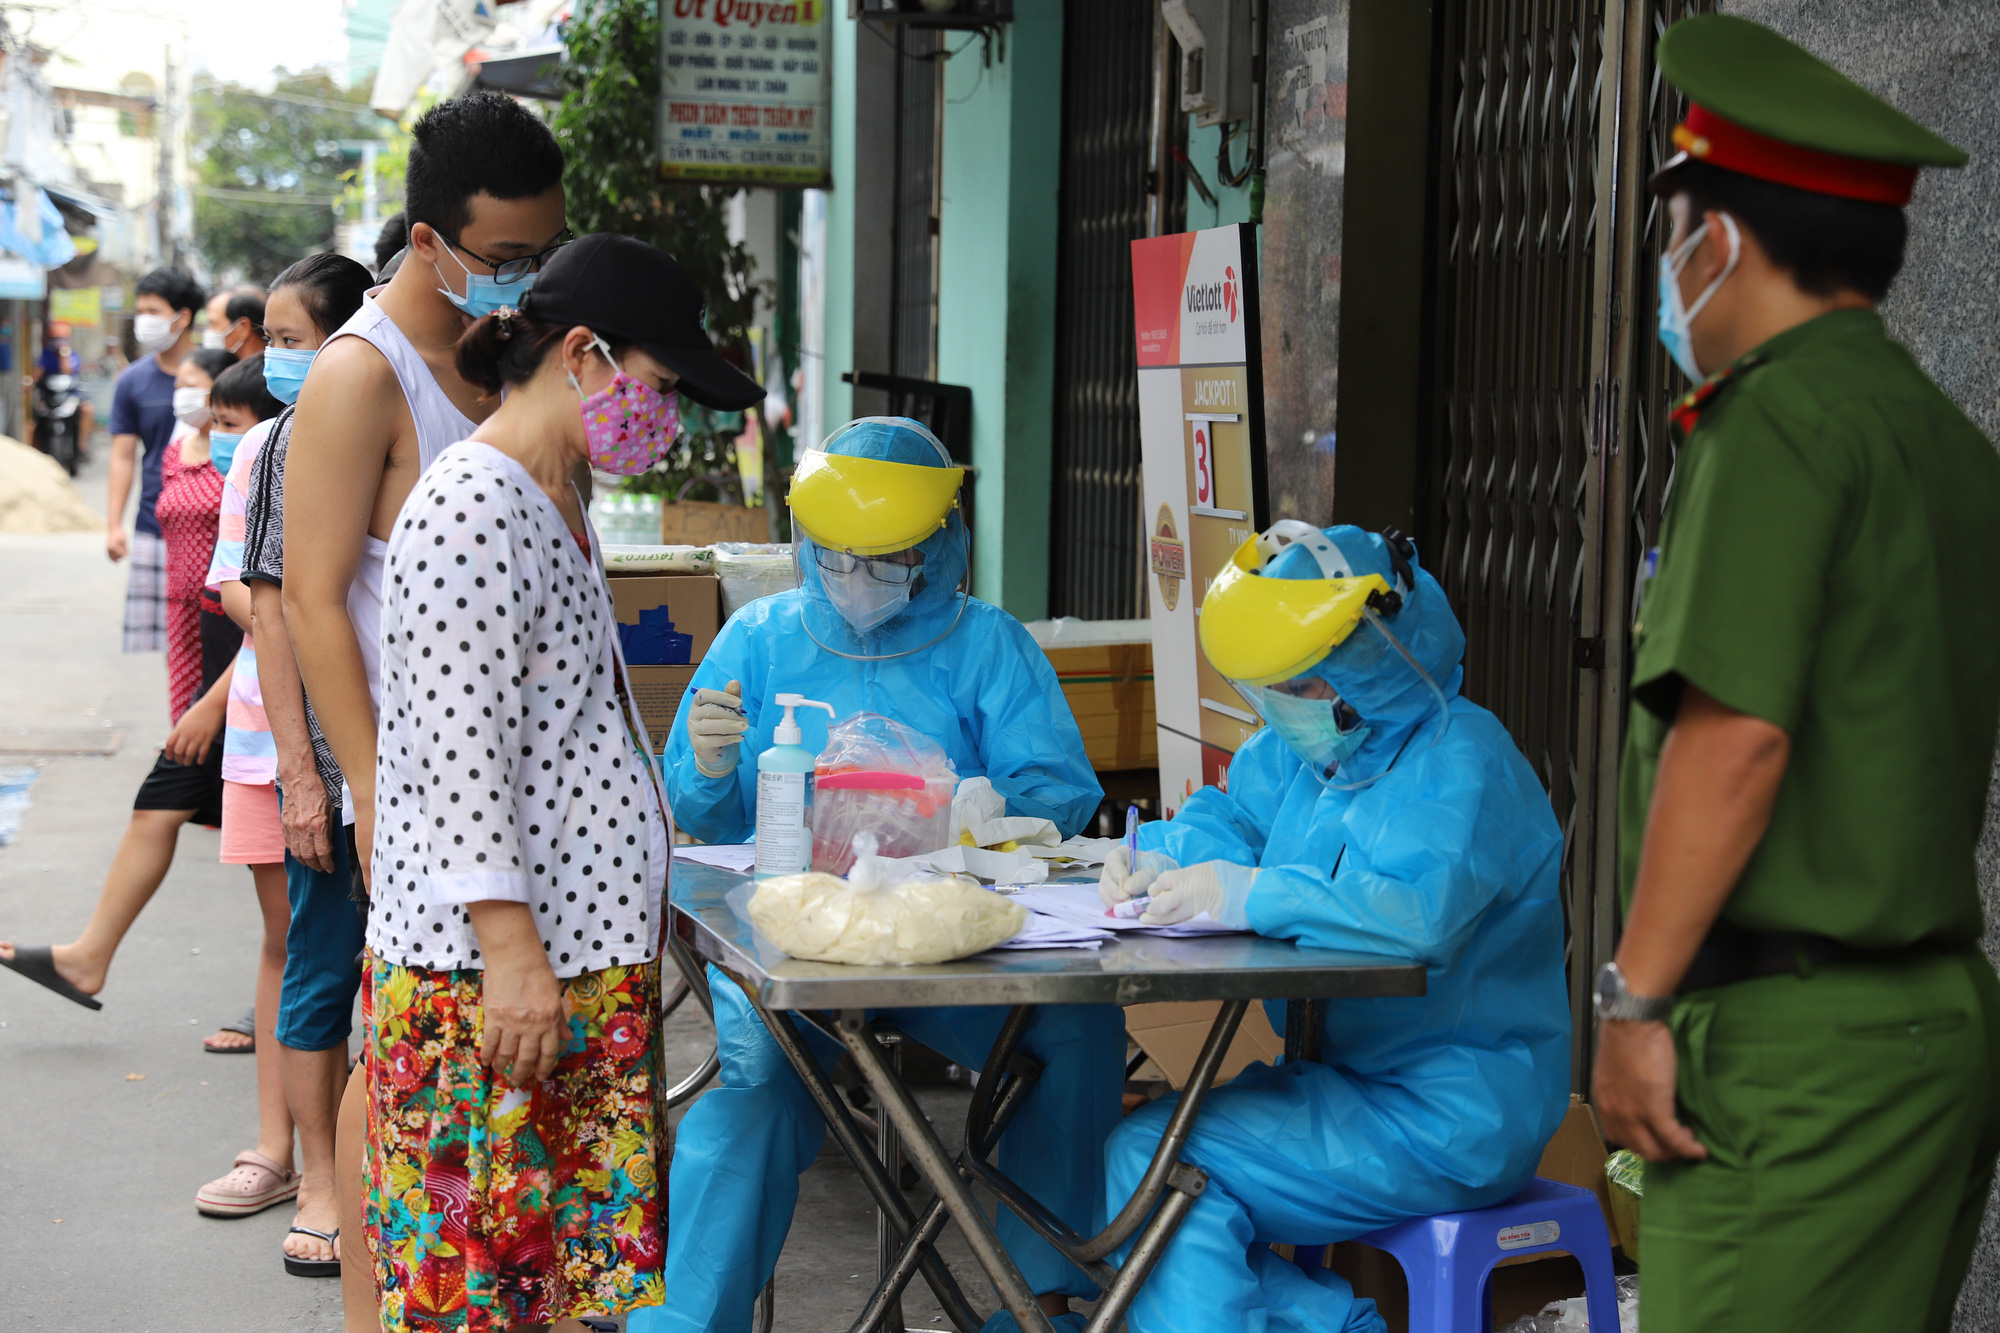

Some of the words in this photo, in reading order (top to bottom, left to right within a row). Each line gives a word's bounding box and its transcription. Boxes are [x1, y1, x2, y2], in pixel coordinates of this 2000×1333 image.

[1186, 282, 1222, 313] Vietlott
[1194, 379, 1231, 406] JACKPOT
[1195, 429, 1209, 503] 3
[1151, 541, 1184, 574] POWER
